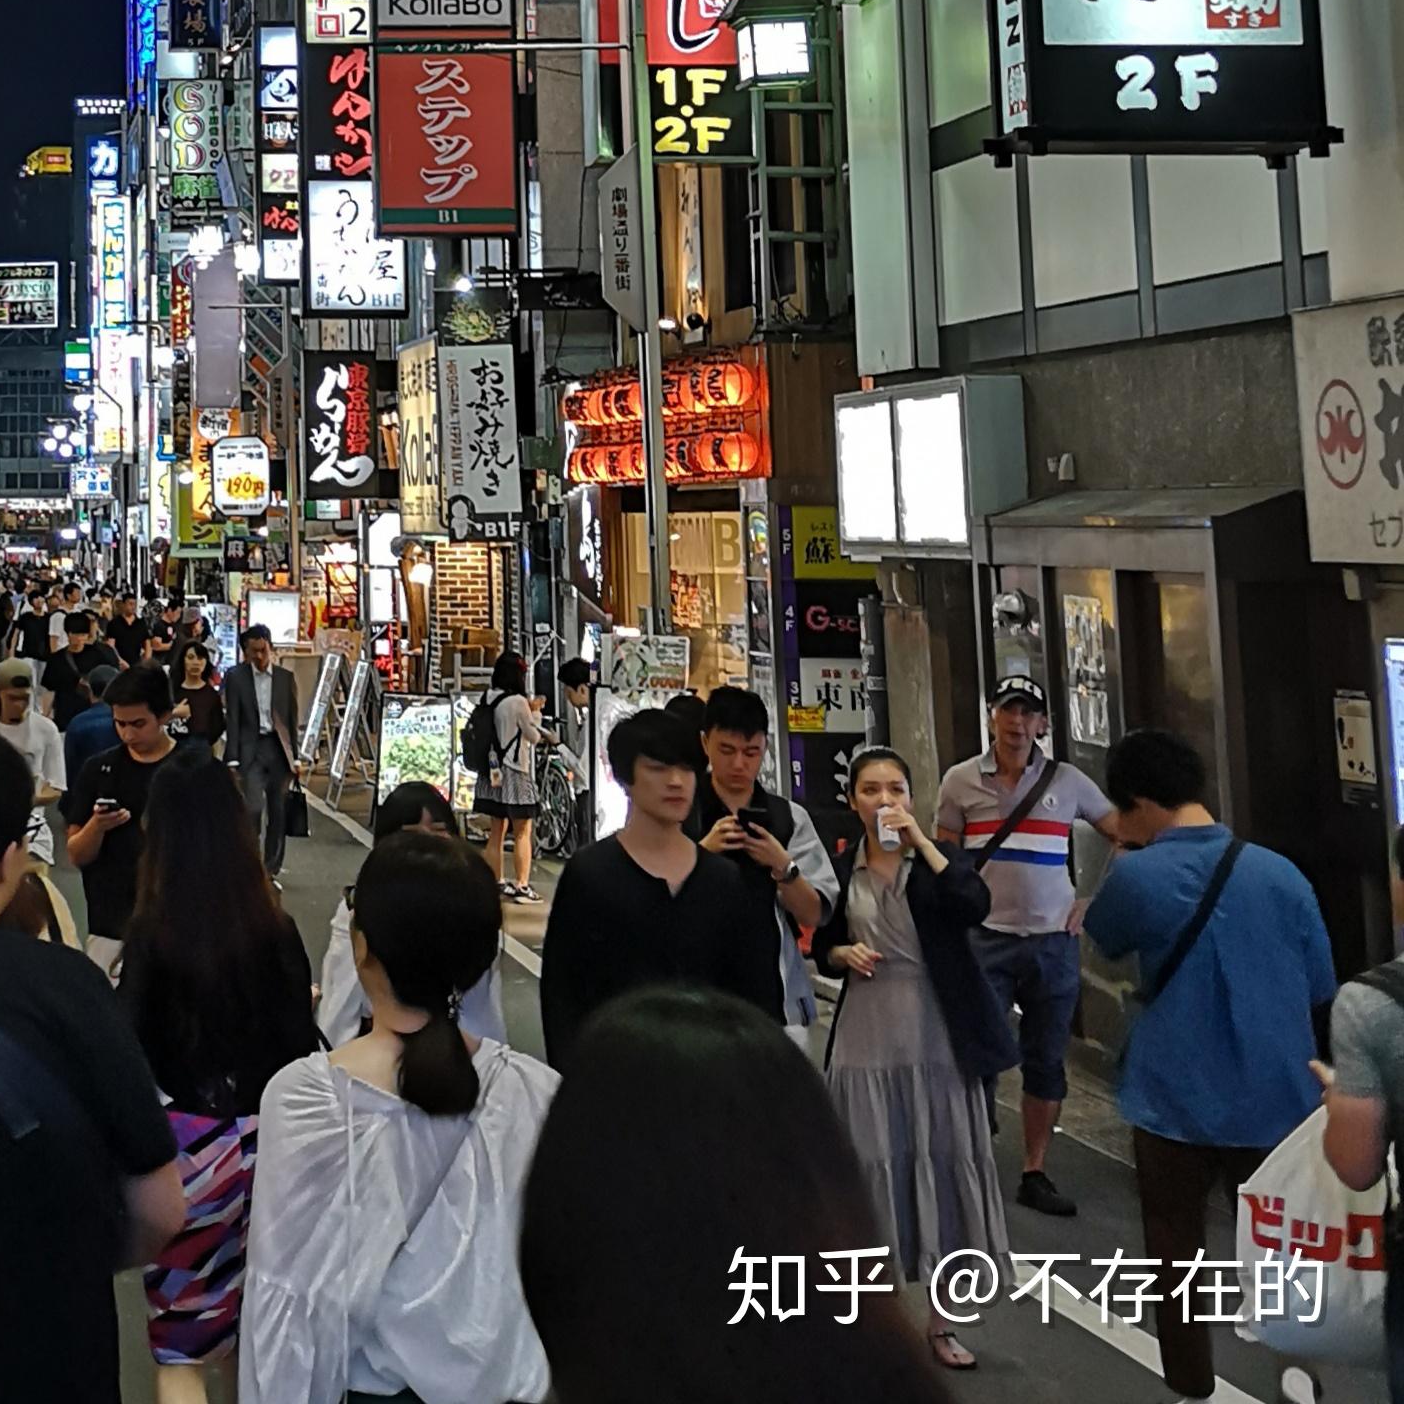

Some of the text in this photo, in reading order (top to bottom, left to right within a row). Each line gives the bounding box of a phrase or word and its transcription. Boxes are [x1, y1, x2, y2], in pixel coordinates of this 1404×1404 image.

[1115, 52, 1219, 111] 2F
[414, 58, 479, 204] ステップ
[653, 115, 731, 156] 2F
[438, 209, 459, 224] B1
[612, 187, 631, 292] 劇場通り一番街
[372, 292, 402, 307] B1F
[347, 361, 371, 456] 東京豚骨
[466, 358, 515, 497] お好み焼き
[484, 521, 522, 538] B1F
